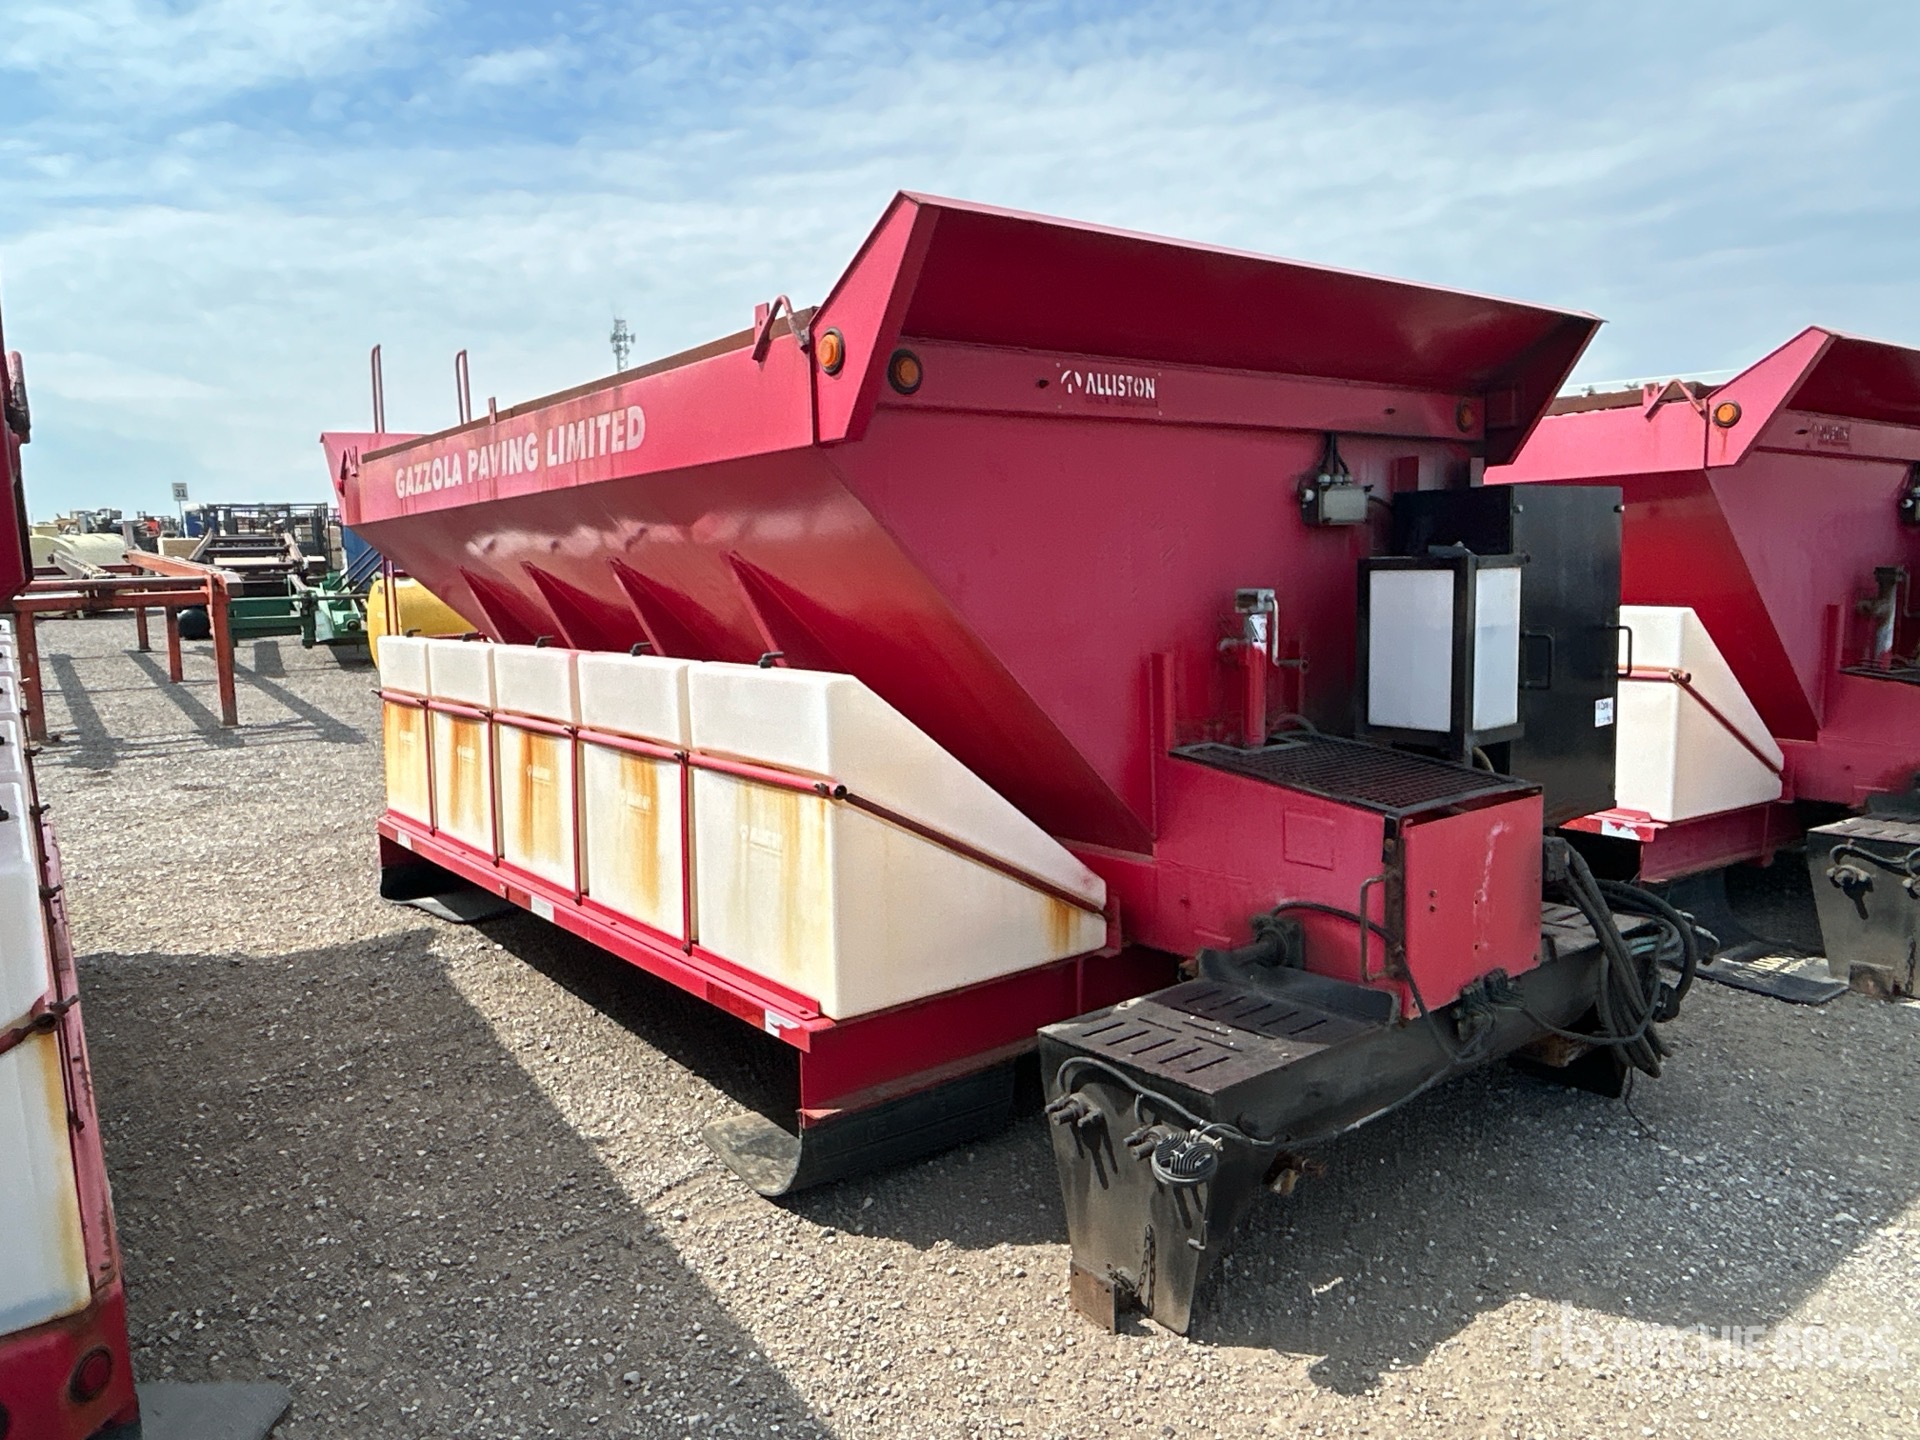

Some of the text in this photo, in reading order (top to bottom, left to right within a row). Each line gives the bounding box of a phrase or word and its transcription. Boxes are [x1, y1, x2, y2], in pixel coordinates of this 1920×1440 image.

[1085, 372, 1156, 399] ALLISTON
[395, 405, 646, 499] GAZZOLA PAVING LIMITED
[175, 488, 187, 498] 31
